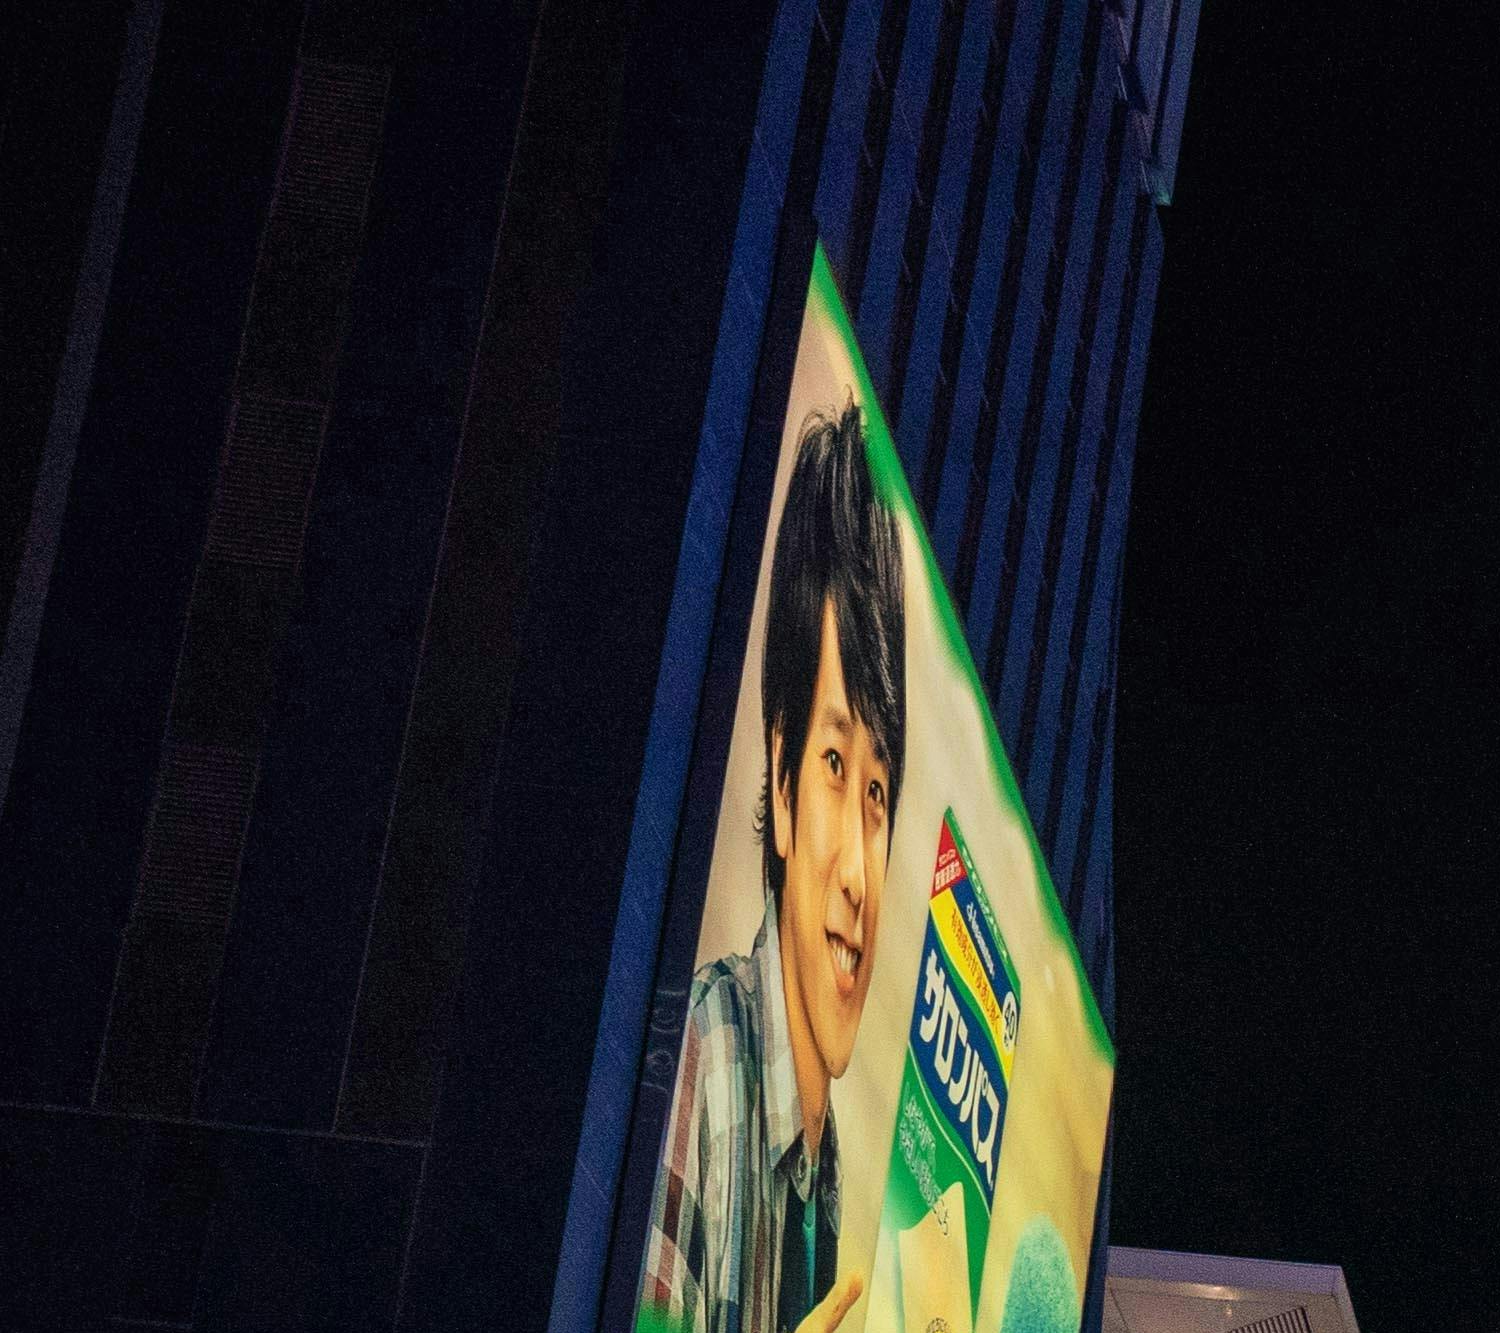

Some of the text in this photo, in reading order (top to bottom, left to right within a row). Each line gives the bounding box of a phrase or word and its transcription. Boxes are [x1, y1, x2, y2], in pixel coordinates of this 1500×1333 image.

[919, 948, 1000, 1191] サロンパス
